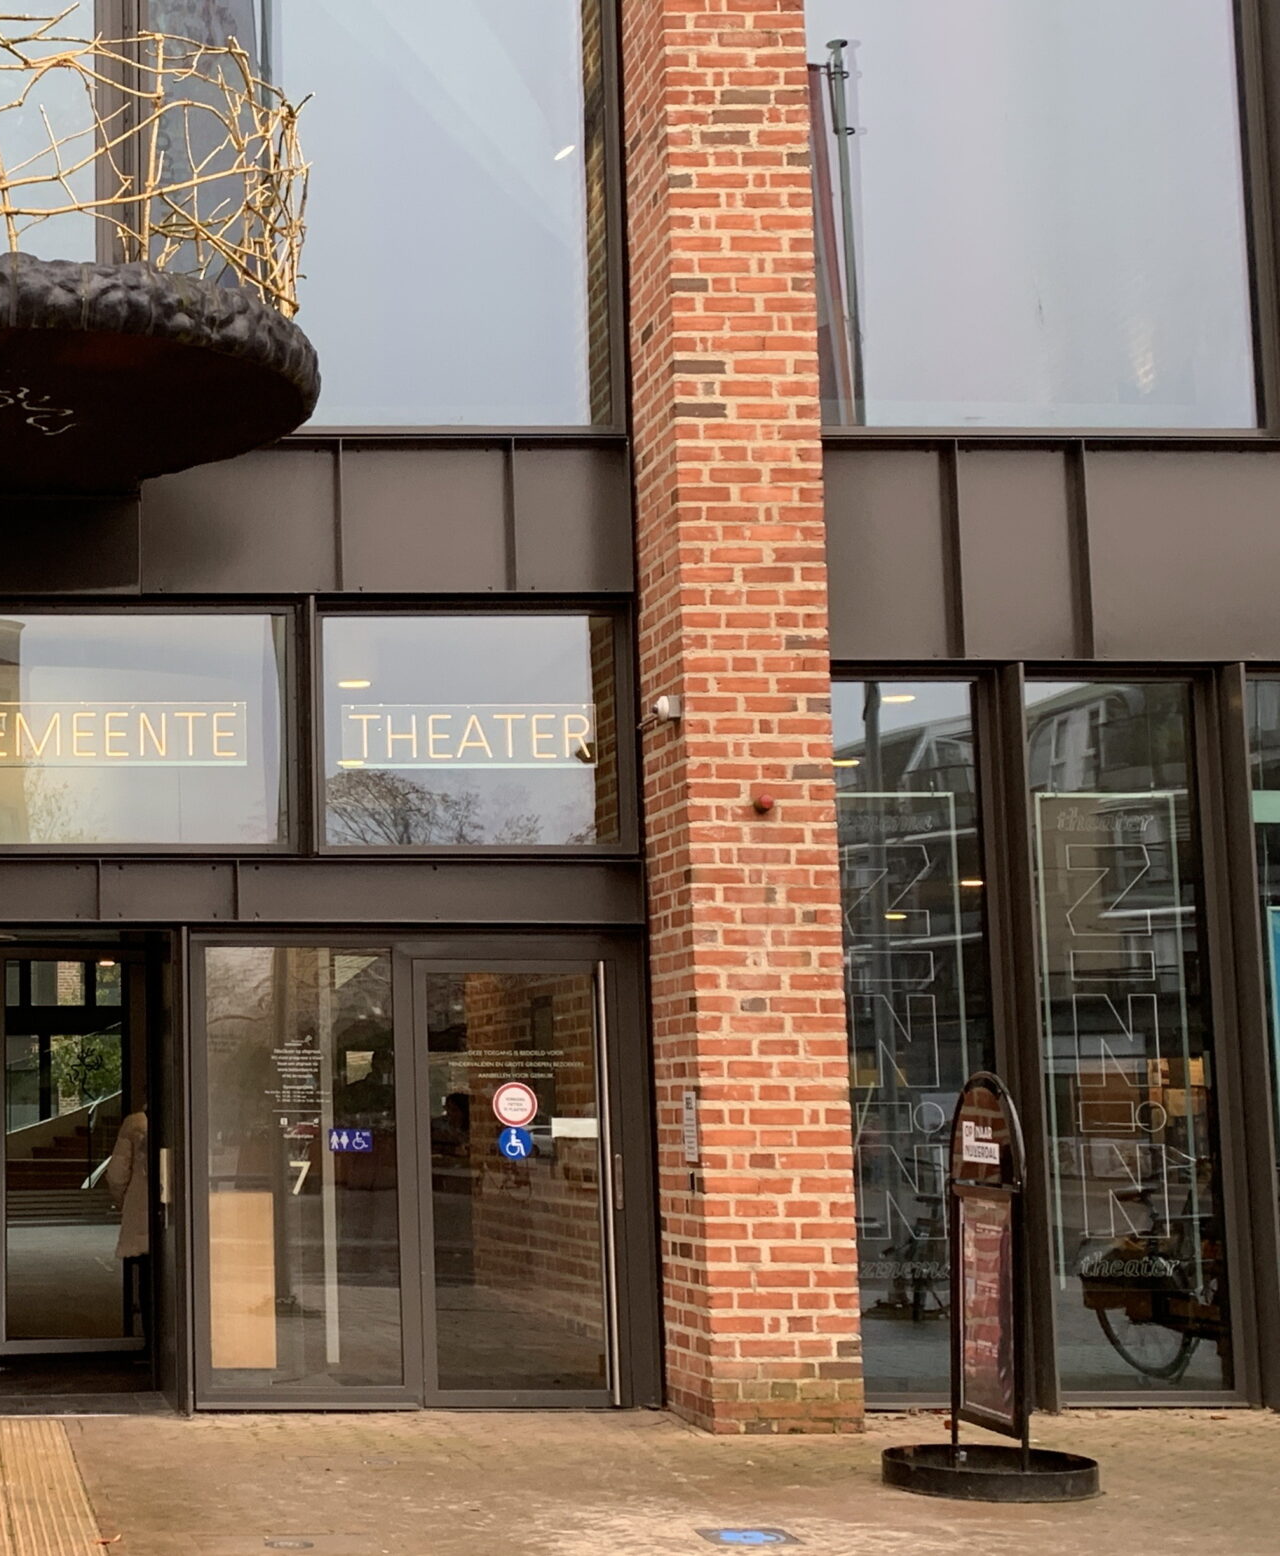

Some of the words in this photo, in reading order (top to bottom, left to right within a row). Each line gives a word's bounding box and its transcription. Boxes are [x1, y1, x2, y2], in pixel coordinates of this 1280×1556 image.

[347, 713, 592, 760] THEATER
[289, 1160, 312, 1195] 7
[1080, 1253, 1181, 1278] theater
